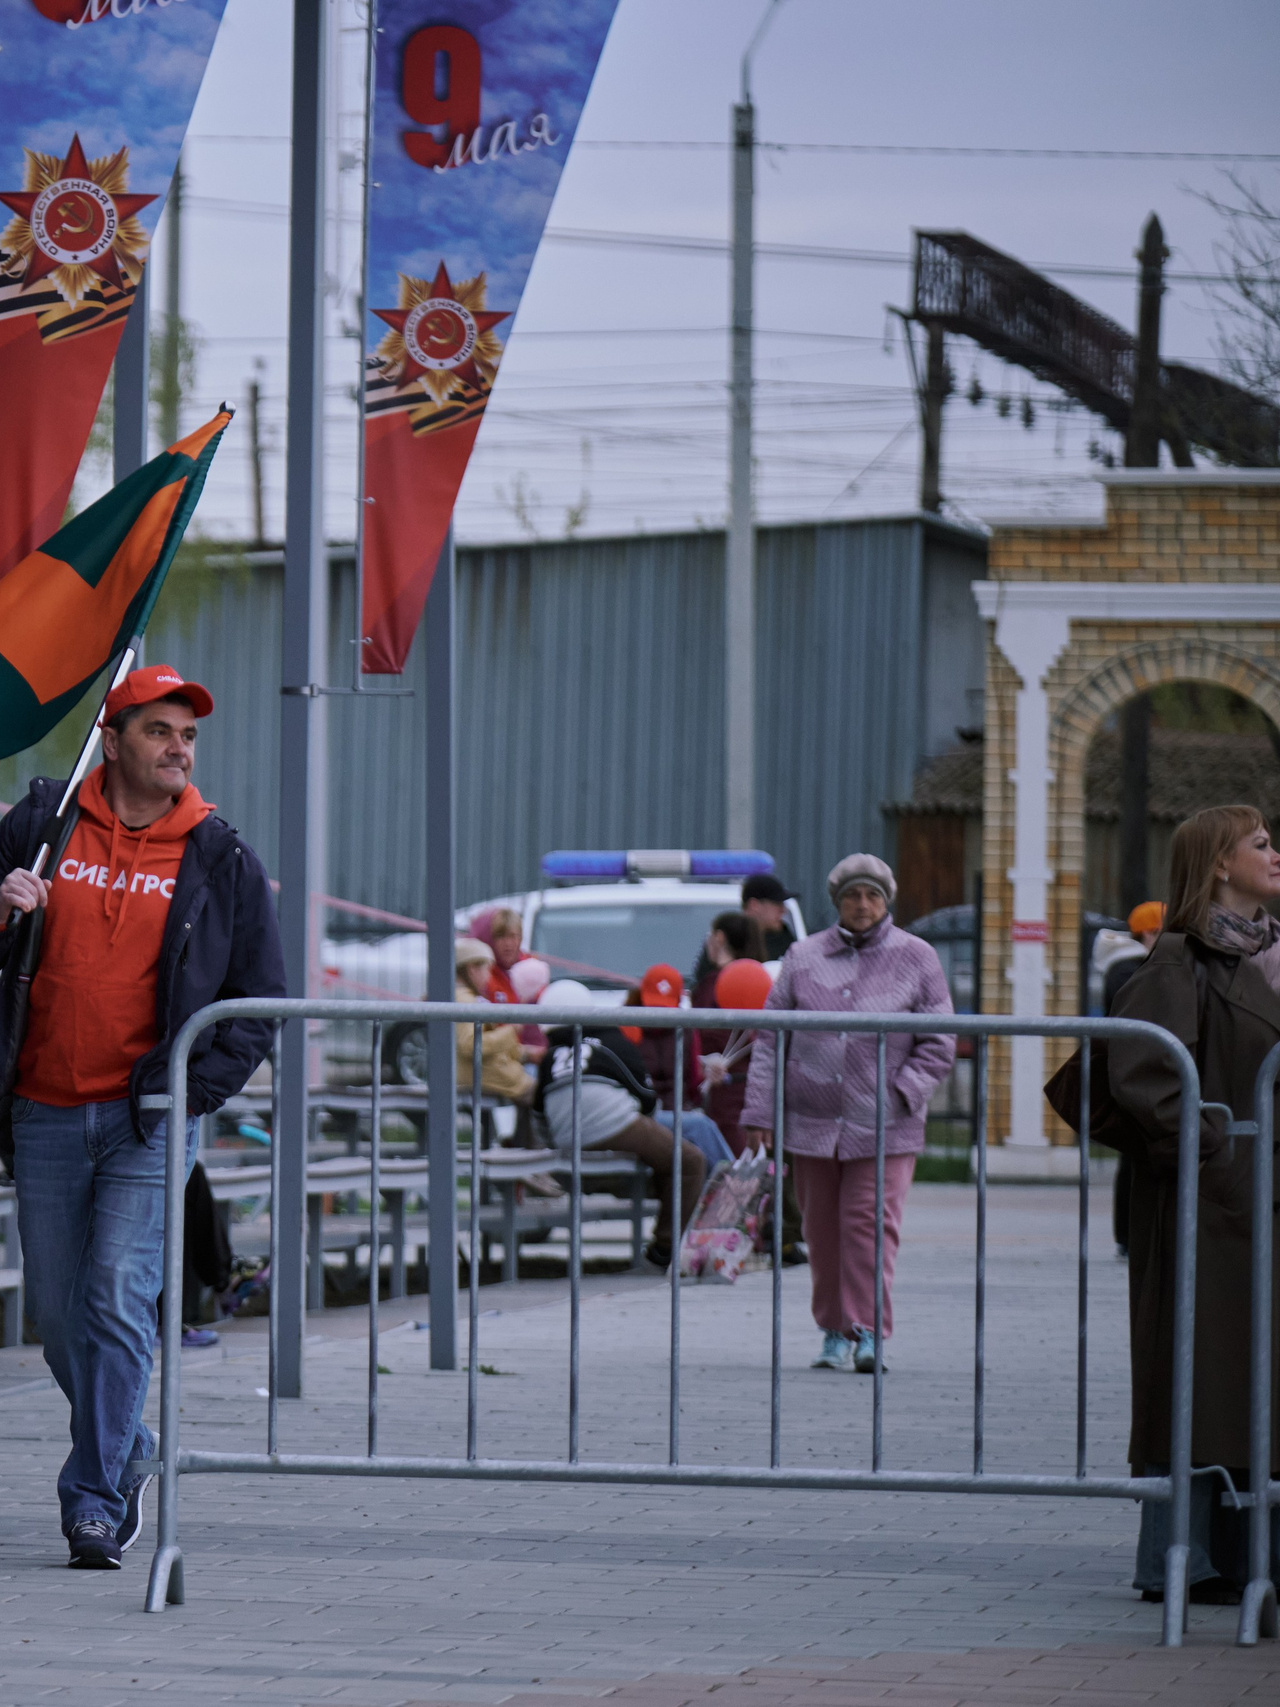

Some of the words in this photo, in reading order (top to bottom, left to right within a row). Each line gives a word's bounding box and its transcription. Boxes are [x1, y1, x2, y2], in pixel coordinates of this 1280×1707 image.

[403, 24, 482, 169] 9
[433, 112, 561, 174] мая
[34, 181, 109, 256] ОТЕЧЕСТВЕННАЯ
[406, 301, 469, 363] ОТЕЧЕСТВЕННАЯ
